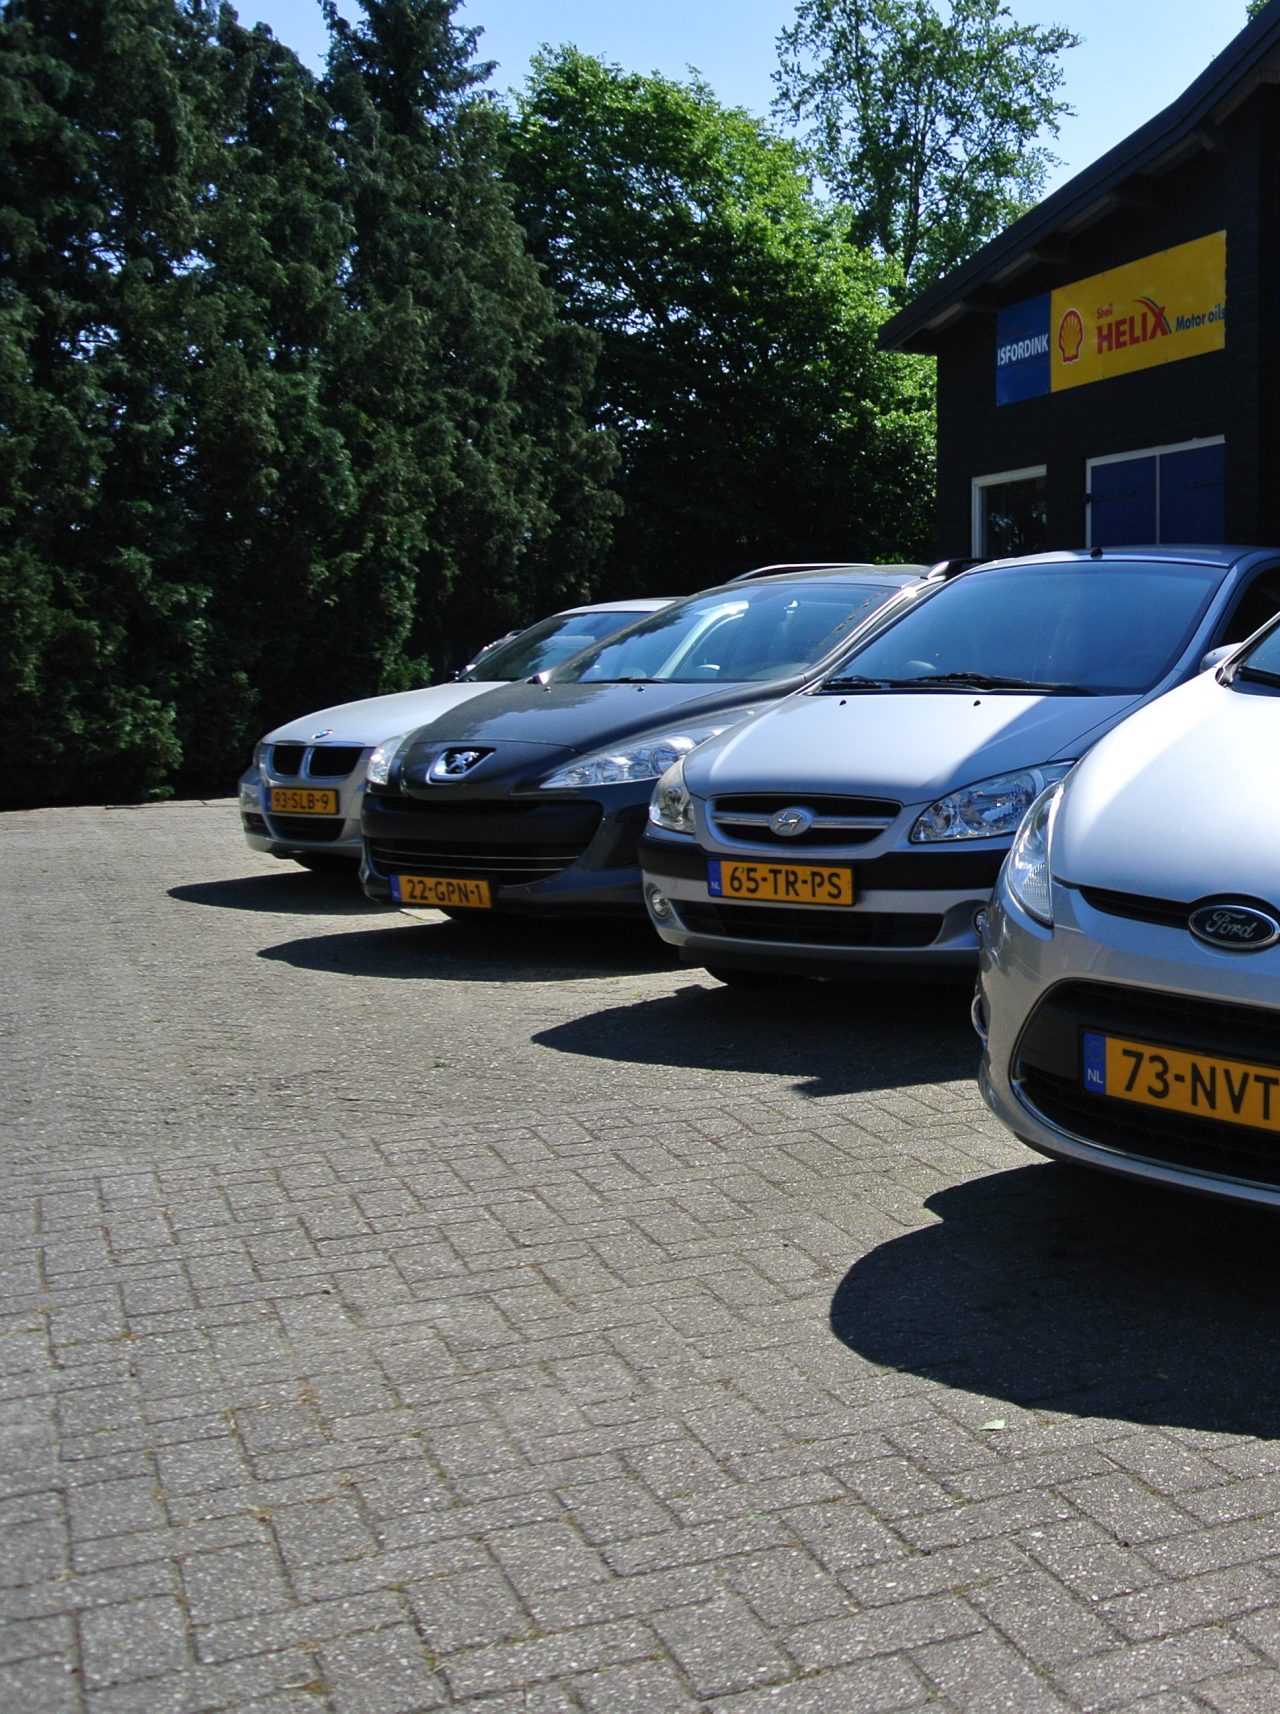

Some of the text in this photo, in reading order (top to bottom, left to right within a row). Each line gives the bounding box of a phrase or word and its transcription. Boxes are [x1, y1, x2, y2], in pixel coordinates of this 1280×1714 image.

[1096, 300, 1227, 355] HELIX Motor oils
[997, 333, 1049, 366] ISFORDINK
[274, 791, 329, 810] 93-SLB-9
[406, 878, 484, 904] 22-GPN-1
[729, 866, 842, 899] 65-TR-PS
[1205, 910, 1258, 938] Ford
[1087, 1068, 1104, 1084] NL
